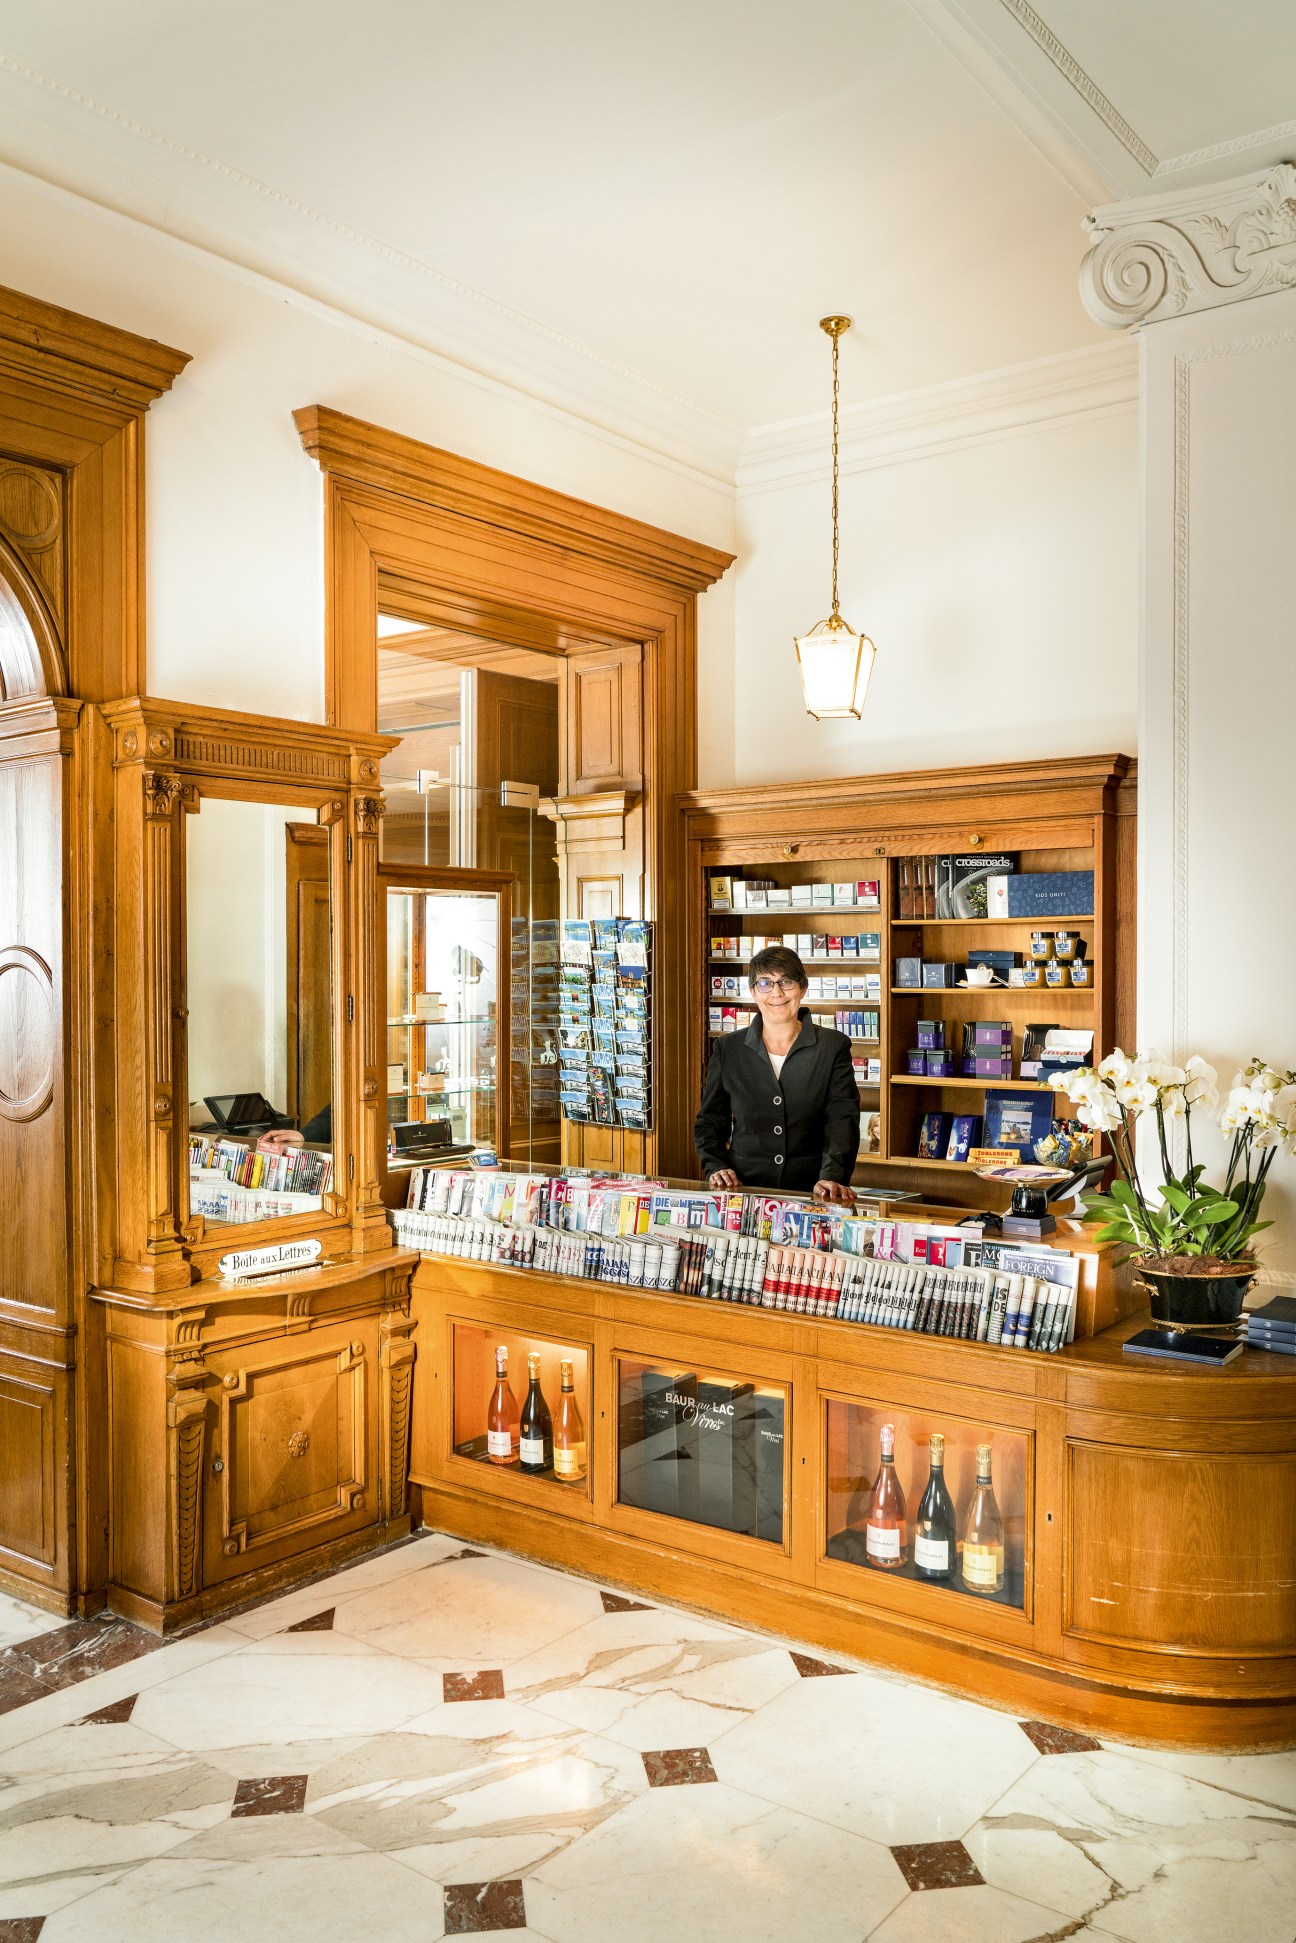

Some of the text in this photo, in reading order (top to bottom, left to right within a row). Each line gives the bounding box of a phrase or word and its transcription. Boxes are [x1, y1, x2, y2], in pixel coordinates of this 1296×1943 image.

[956, 856, 1010, 867] crossroads
[974, 1157, 1007, 1165] TOBLERONE
[655, 1197, 670, 1207] DIE
[260, 1254, 277, 1264] aux
[279, 1246, 312, 1261] Lettres
[1004, 1261, 1055, 1276] FOREIGN
[665, 1392, 696, 1408] BAUR
[712, 1401, 735, 1416] LAC
